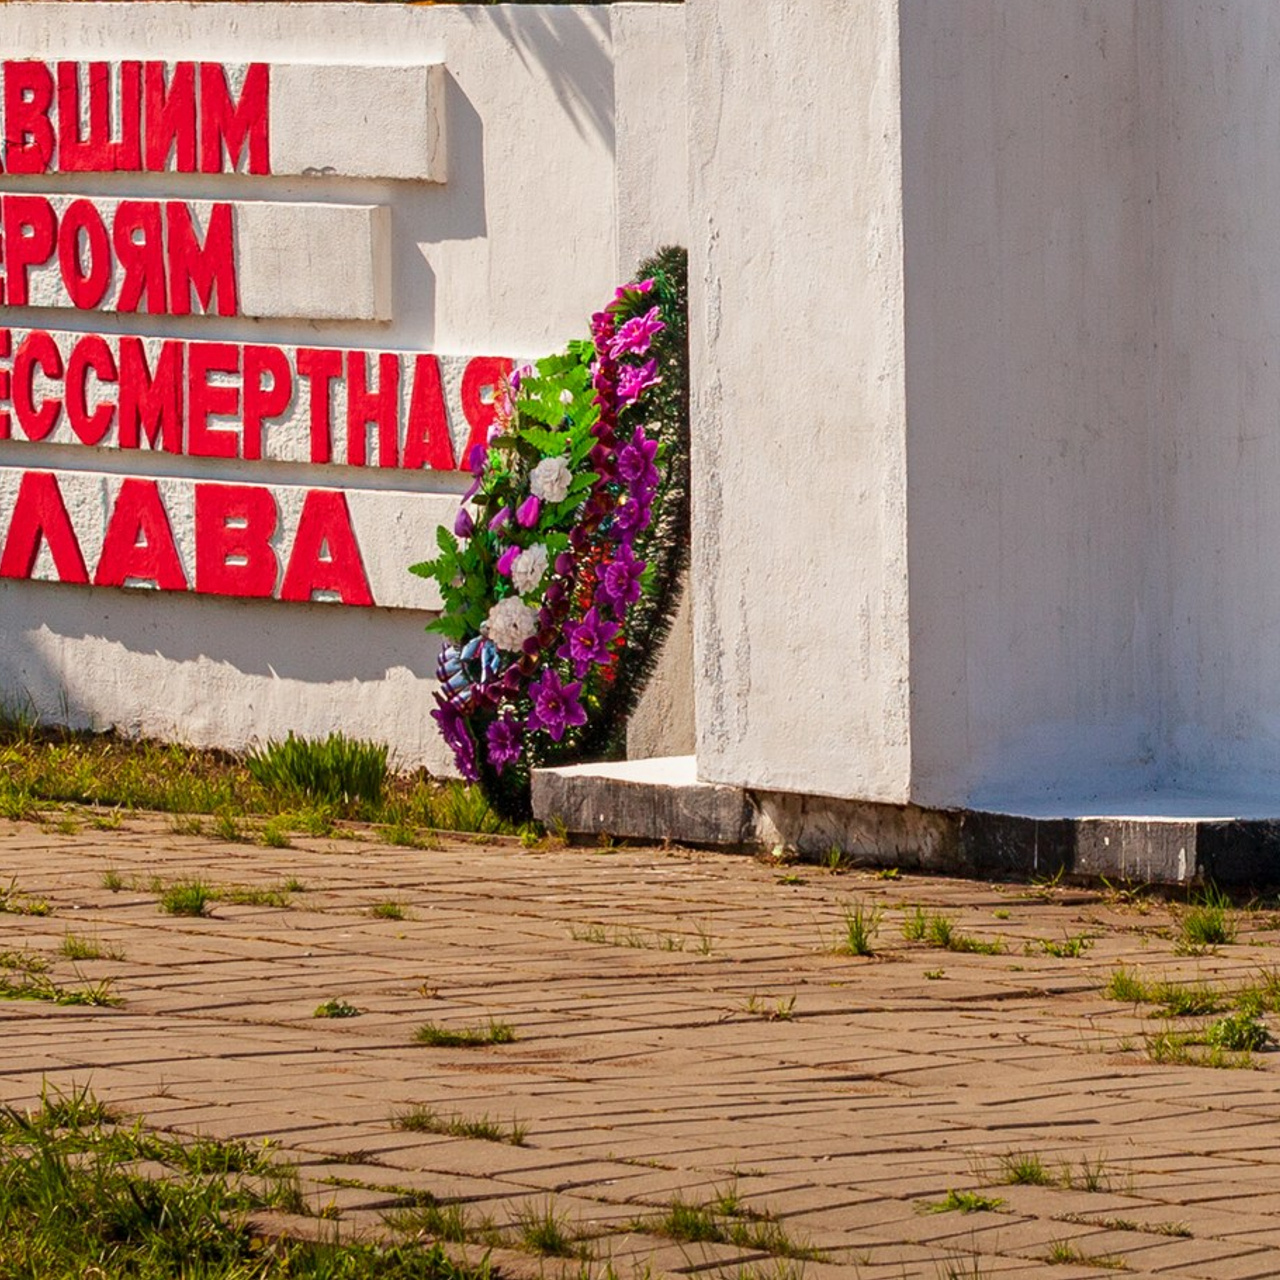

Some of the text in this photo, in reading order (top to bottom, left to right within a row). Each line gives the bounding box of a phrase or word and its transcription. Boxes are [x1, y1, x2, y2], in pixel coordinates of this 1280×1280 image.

[0, 60, 270, 176] ВШИМ
[0, 195, 238, 316] РОЯМ
[0, 328, 514, 472] ССМЕРТНАЯ
[0, 472, 374, 606] ЛАВА
